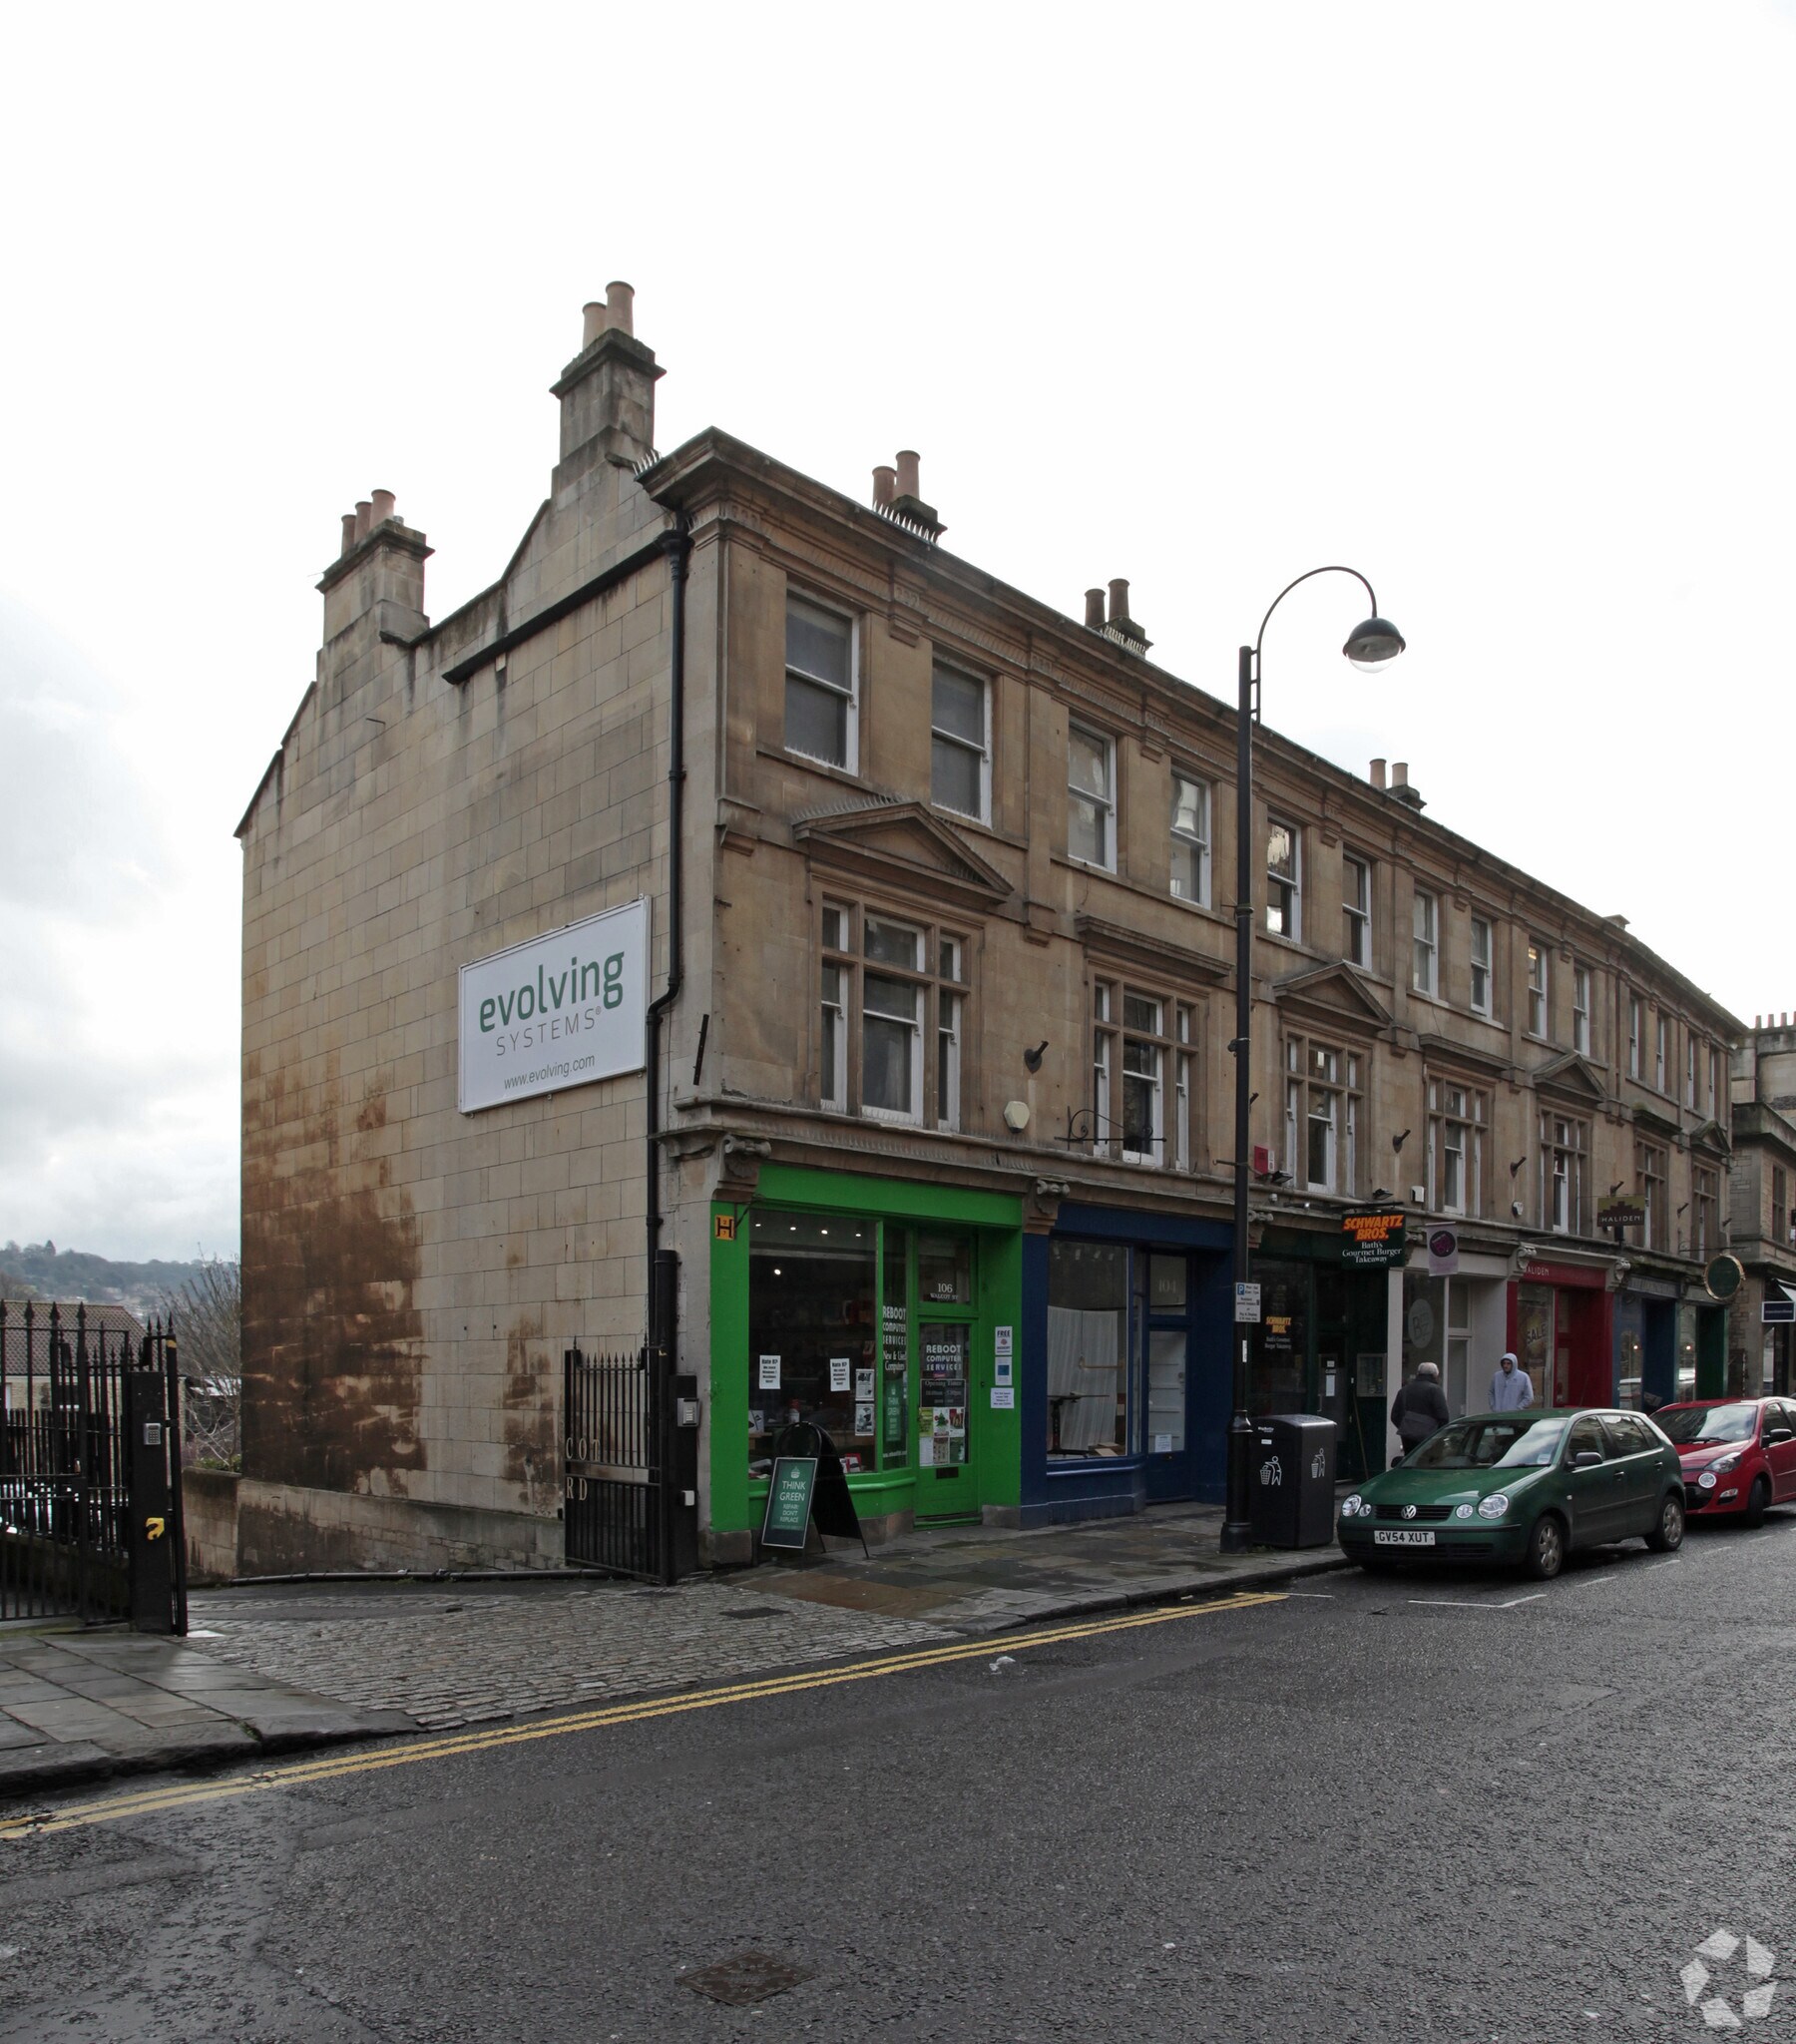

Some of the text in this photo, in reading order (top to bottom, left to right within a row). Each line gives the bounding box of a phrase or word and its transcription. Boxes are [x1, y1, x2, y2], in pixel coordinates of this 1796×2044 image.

[480, 951, 625, 1033] evolving
[504, 1054, 595, 1090] www.evolving.com
[1343, 1215, 1404, 1230] SCHWARTZ
[1356, 1228, 1389, 1240] BROS.
[1376, 1248, 1402, 1257] Burger
[1525, 1266, 1549, 1276] ALIDEN
[938, 1283, 953, 1293] 106
[883, 1305, 906, 1320] REBOOT
[926, 1344, 961, 1354] REBOOT
[782, 1481, 806, 1490] THINK
[780, 1492, 805, 1501] GREEN
[1379, 1532, 1429, 1543] GV54 XUT
